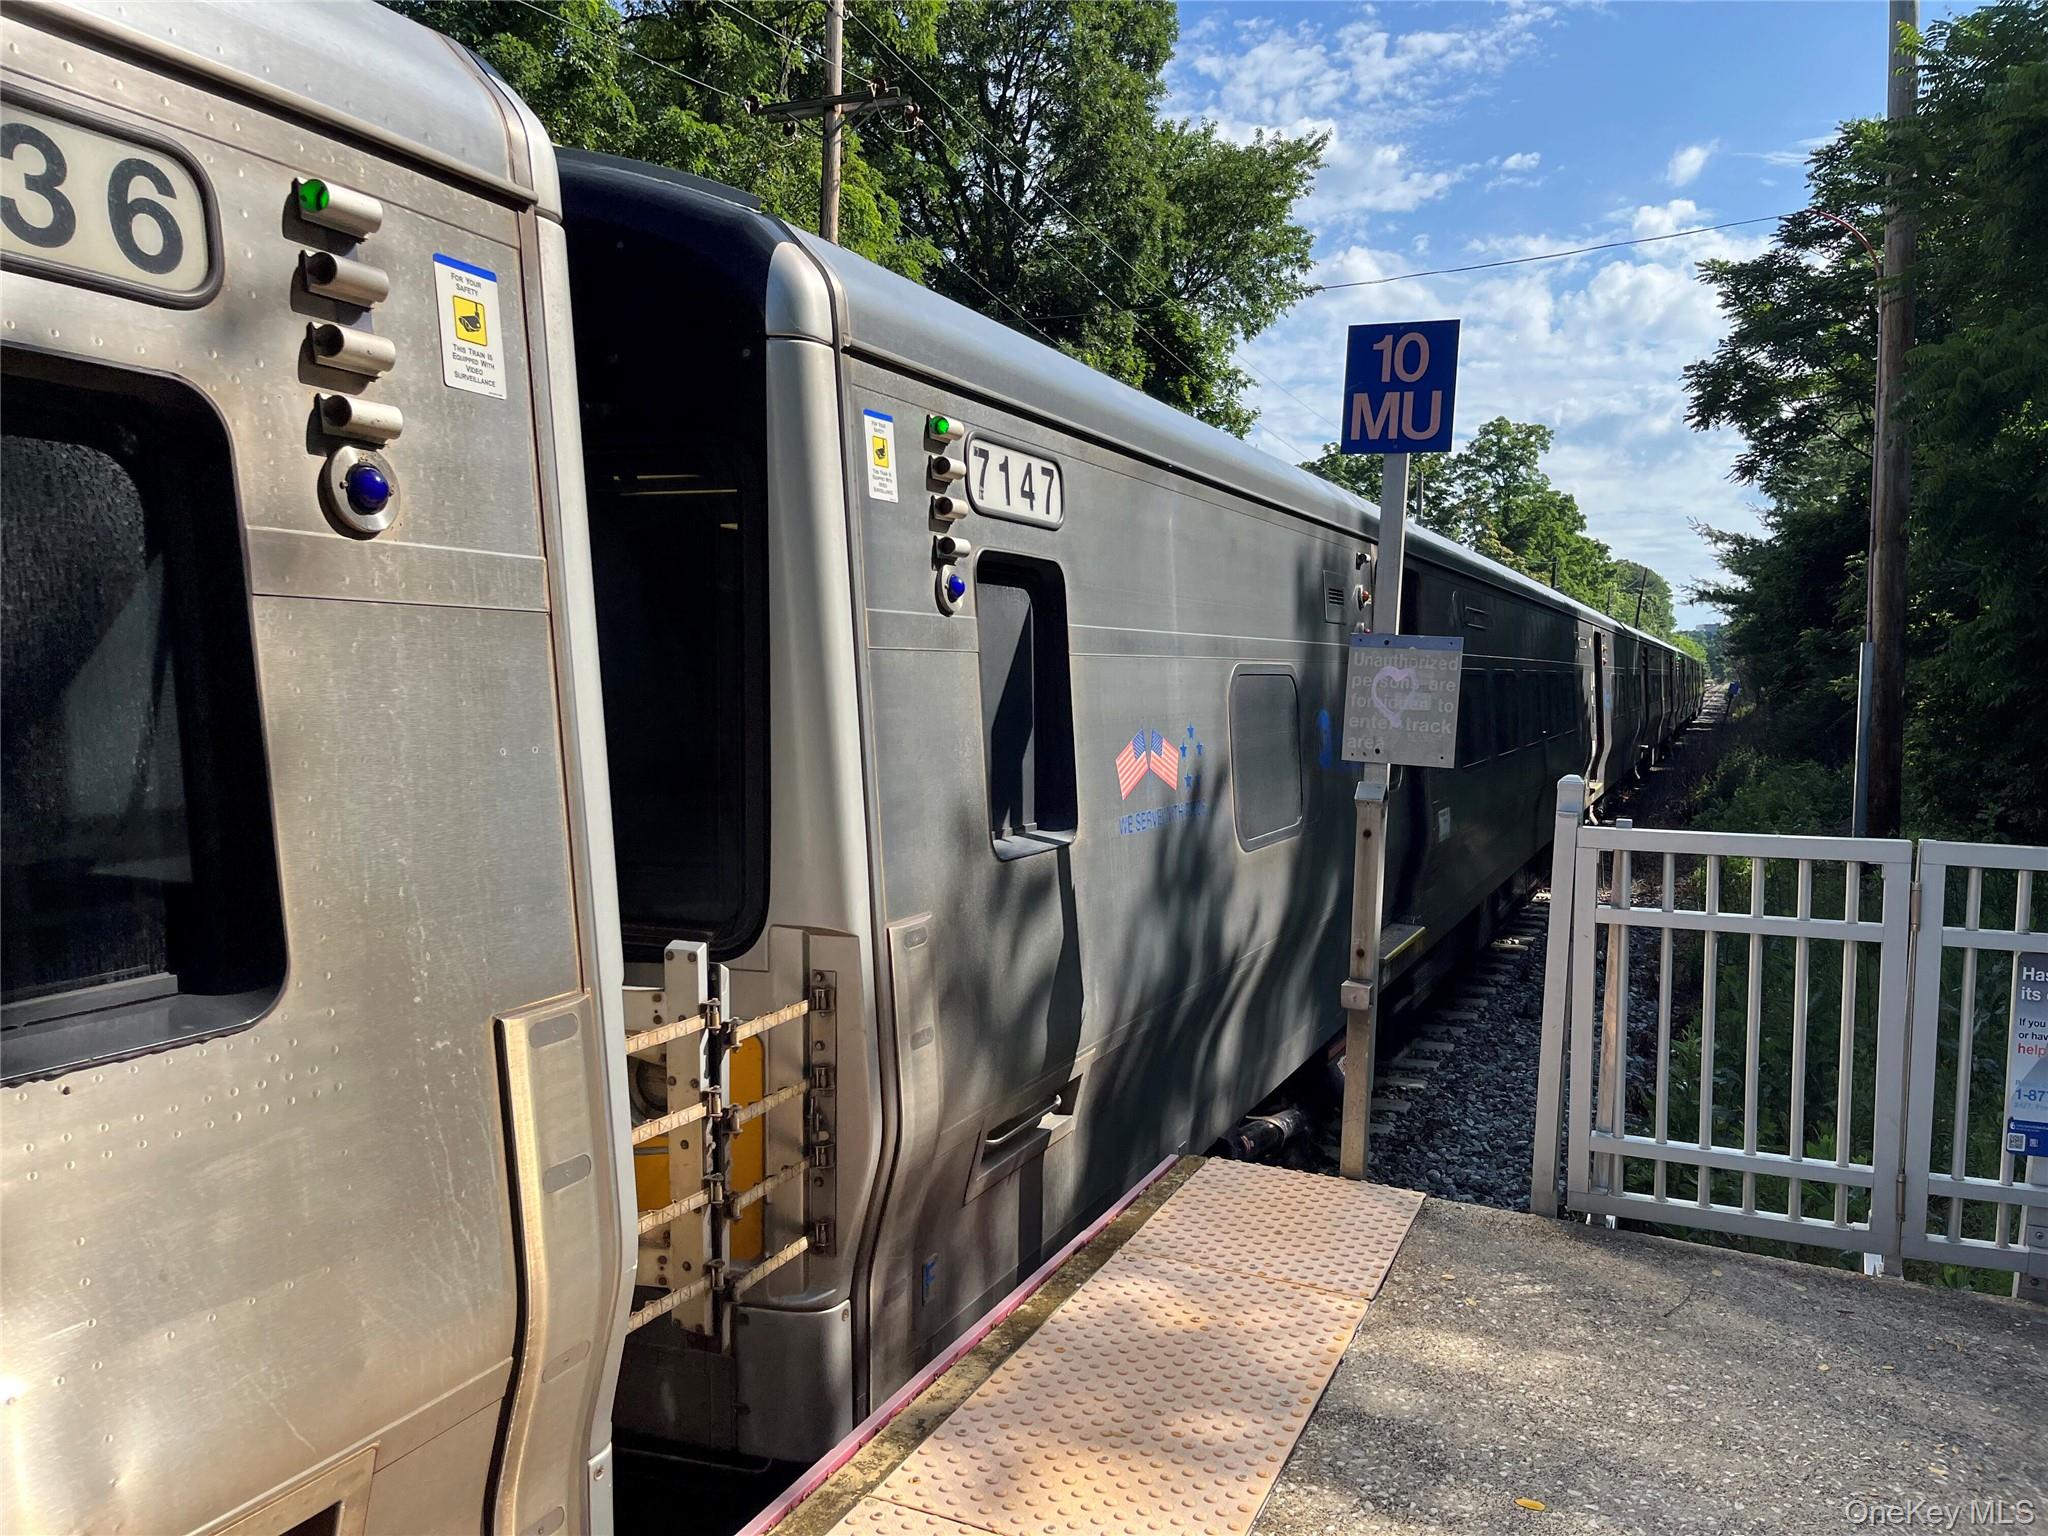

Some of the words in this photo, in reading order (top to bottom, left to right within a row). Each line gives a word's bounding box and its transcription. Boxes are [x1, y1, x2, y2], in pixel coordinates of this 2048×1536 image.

[451, 273, 463, 283] FOR
[465, 277, 482, 289] YOUR
[456, 284, 479, 297] SAFETY
[1373, 332, 1430, 383] 10
[1351, 390, 1442, 440] MU
[974, 446, 1055, 515] 7147
[1353, 651, 1459, 671] Unauthorized
[1429, 679, 1457, 692] are
[1438, 698, 1454, 713] to
[1406, 717, 1453, 735] track
[1347, 736, 1385, 752] area
[2021, 986, 2041, 1001] its
[2019, 1018, 2026, 1026] If
[2028, 1020, 2046, 1029] you
[2018, 1032, 2029, 1040] or
